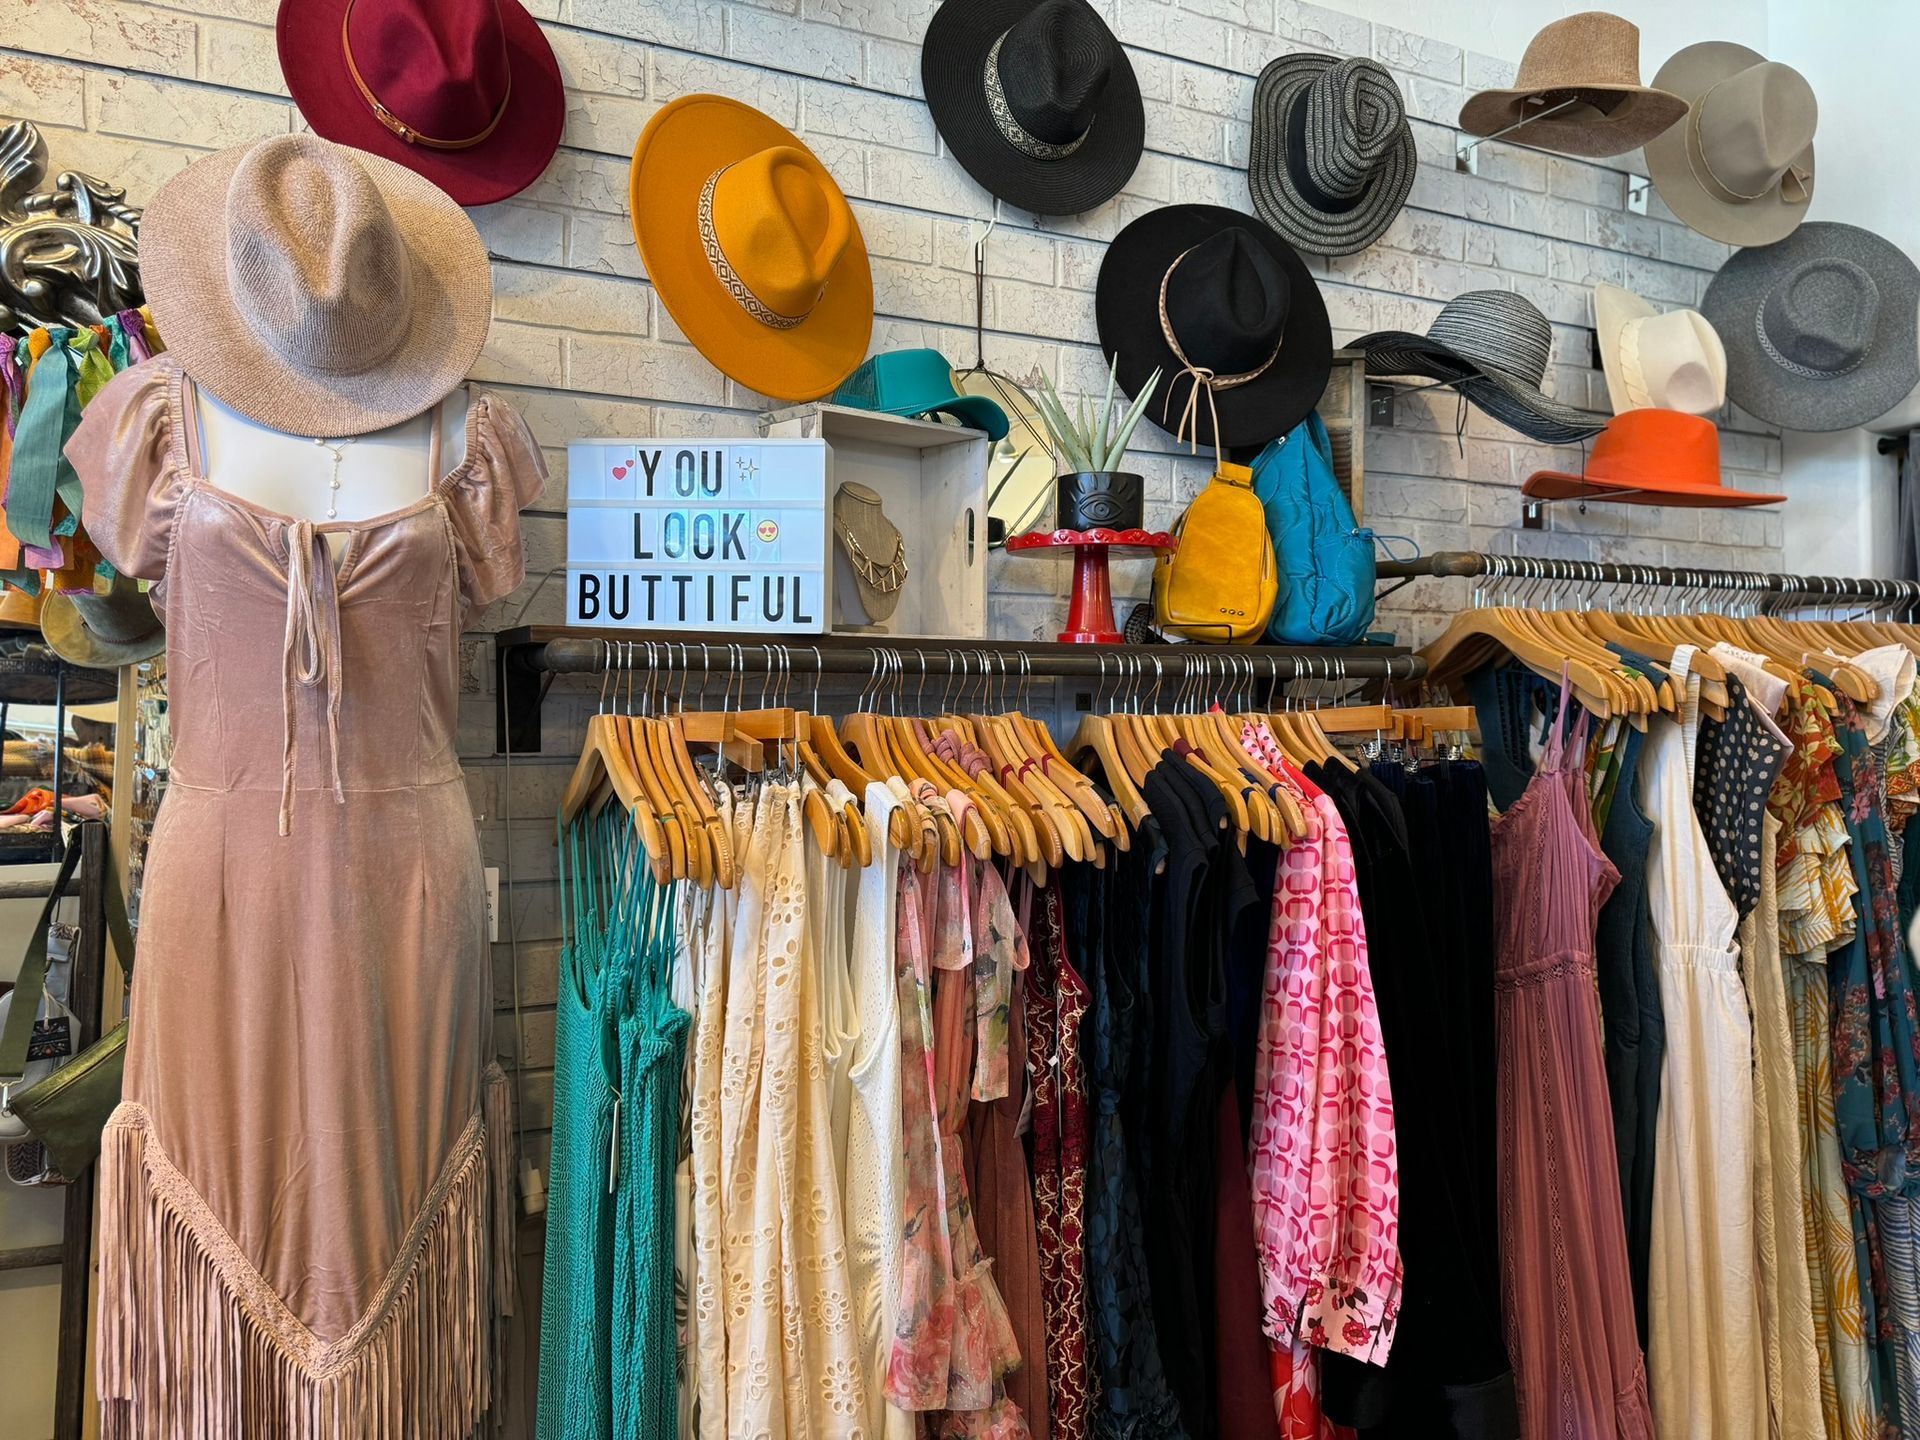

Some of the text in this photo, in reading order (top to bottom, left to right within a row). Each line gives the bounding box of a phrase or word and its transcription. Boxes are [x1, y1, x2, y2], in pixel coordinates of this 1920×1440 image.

[638, 449, 723, 497] YOU
[633, 511, 746, 560] LOOK
[578, 573, 813, 624] BUTTIFUL
